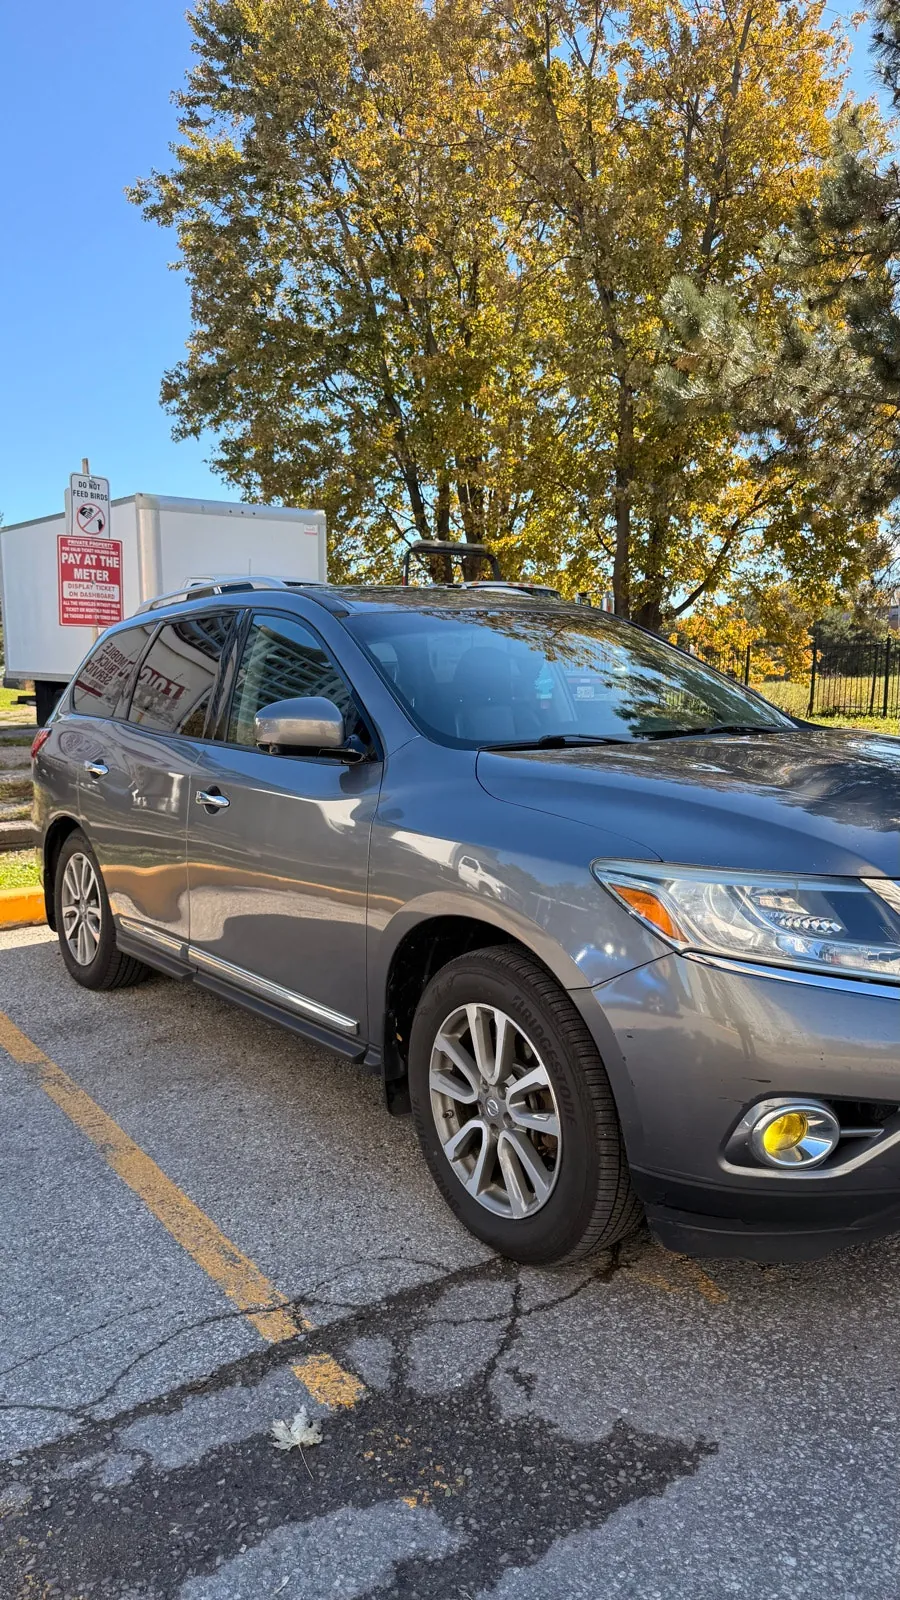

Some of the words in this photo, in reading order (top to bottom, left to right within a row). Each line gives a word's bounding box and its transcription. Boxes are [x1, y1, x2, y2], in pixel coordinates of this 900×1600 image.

[89, 482, 100, 490] NOT
[72, 490, 88, 498] FEED
[90, 492, 108, 501] BIRDS
[62, 552, 82, 564] PAY
[84, 554, 98, 566] AT
[100, 556, 120, 568] THE
[74, 568, 109, 582] METER
